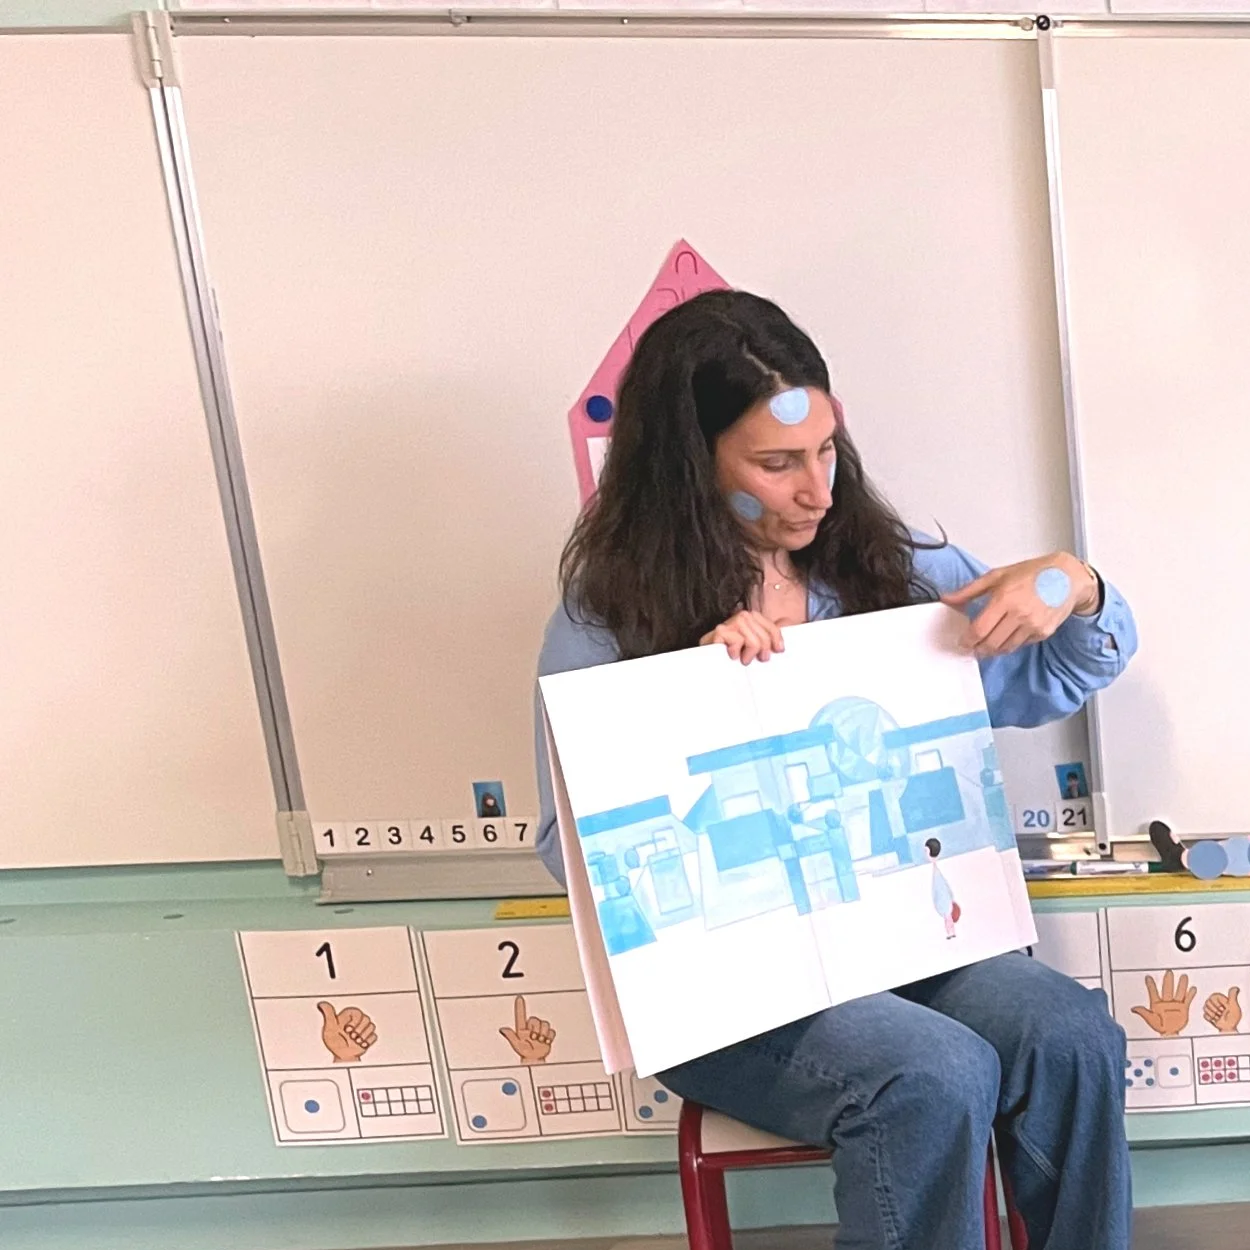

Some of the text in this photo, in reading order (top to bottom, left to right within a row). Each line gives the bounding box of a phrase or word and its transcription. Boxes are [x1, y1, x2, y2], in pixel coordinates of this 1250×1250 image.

[322, 823, 528, 847] 1 2 3 4 5 6 7
[1022, 807, 1088, 828] 20 21
[1174, 916, 1197, 952] 6
[315, 942, 336, 979] 1
[497, 941, 525, 979] 2
